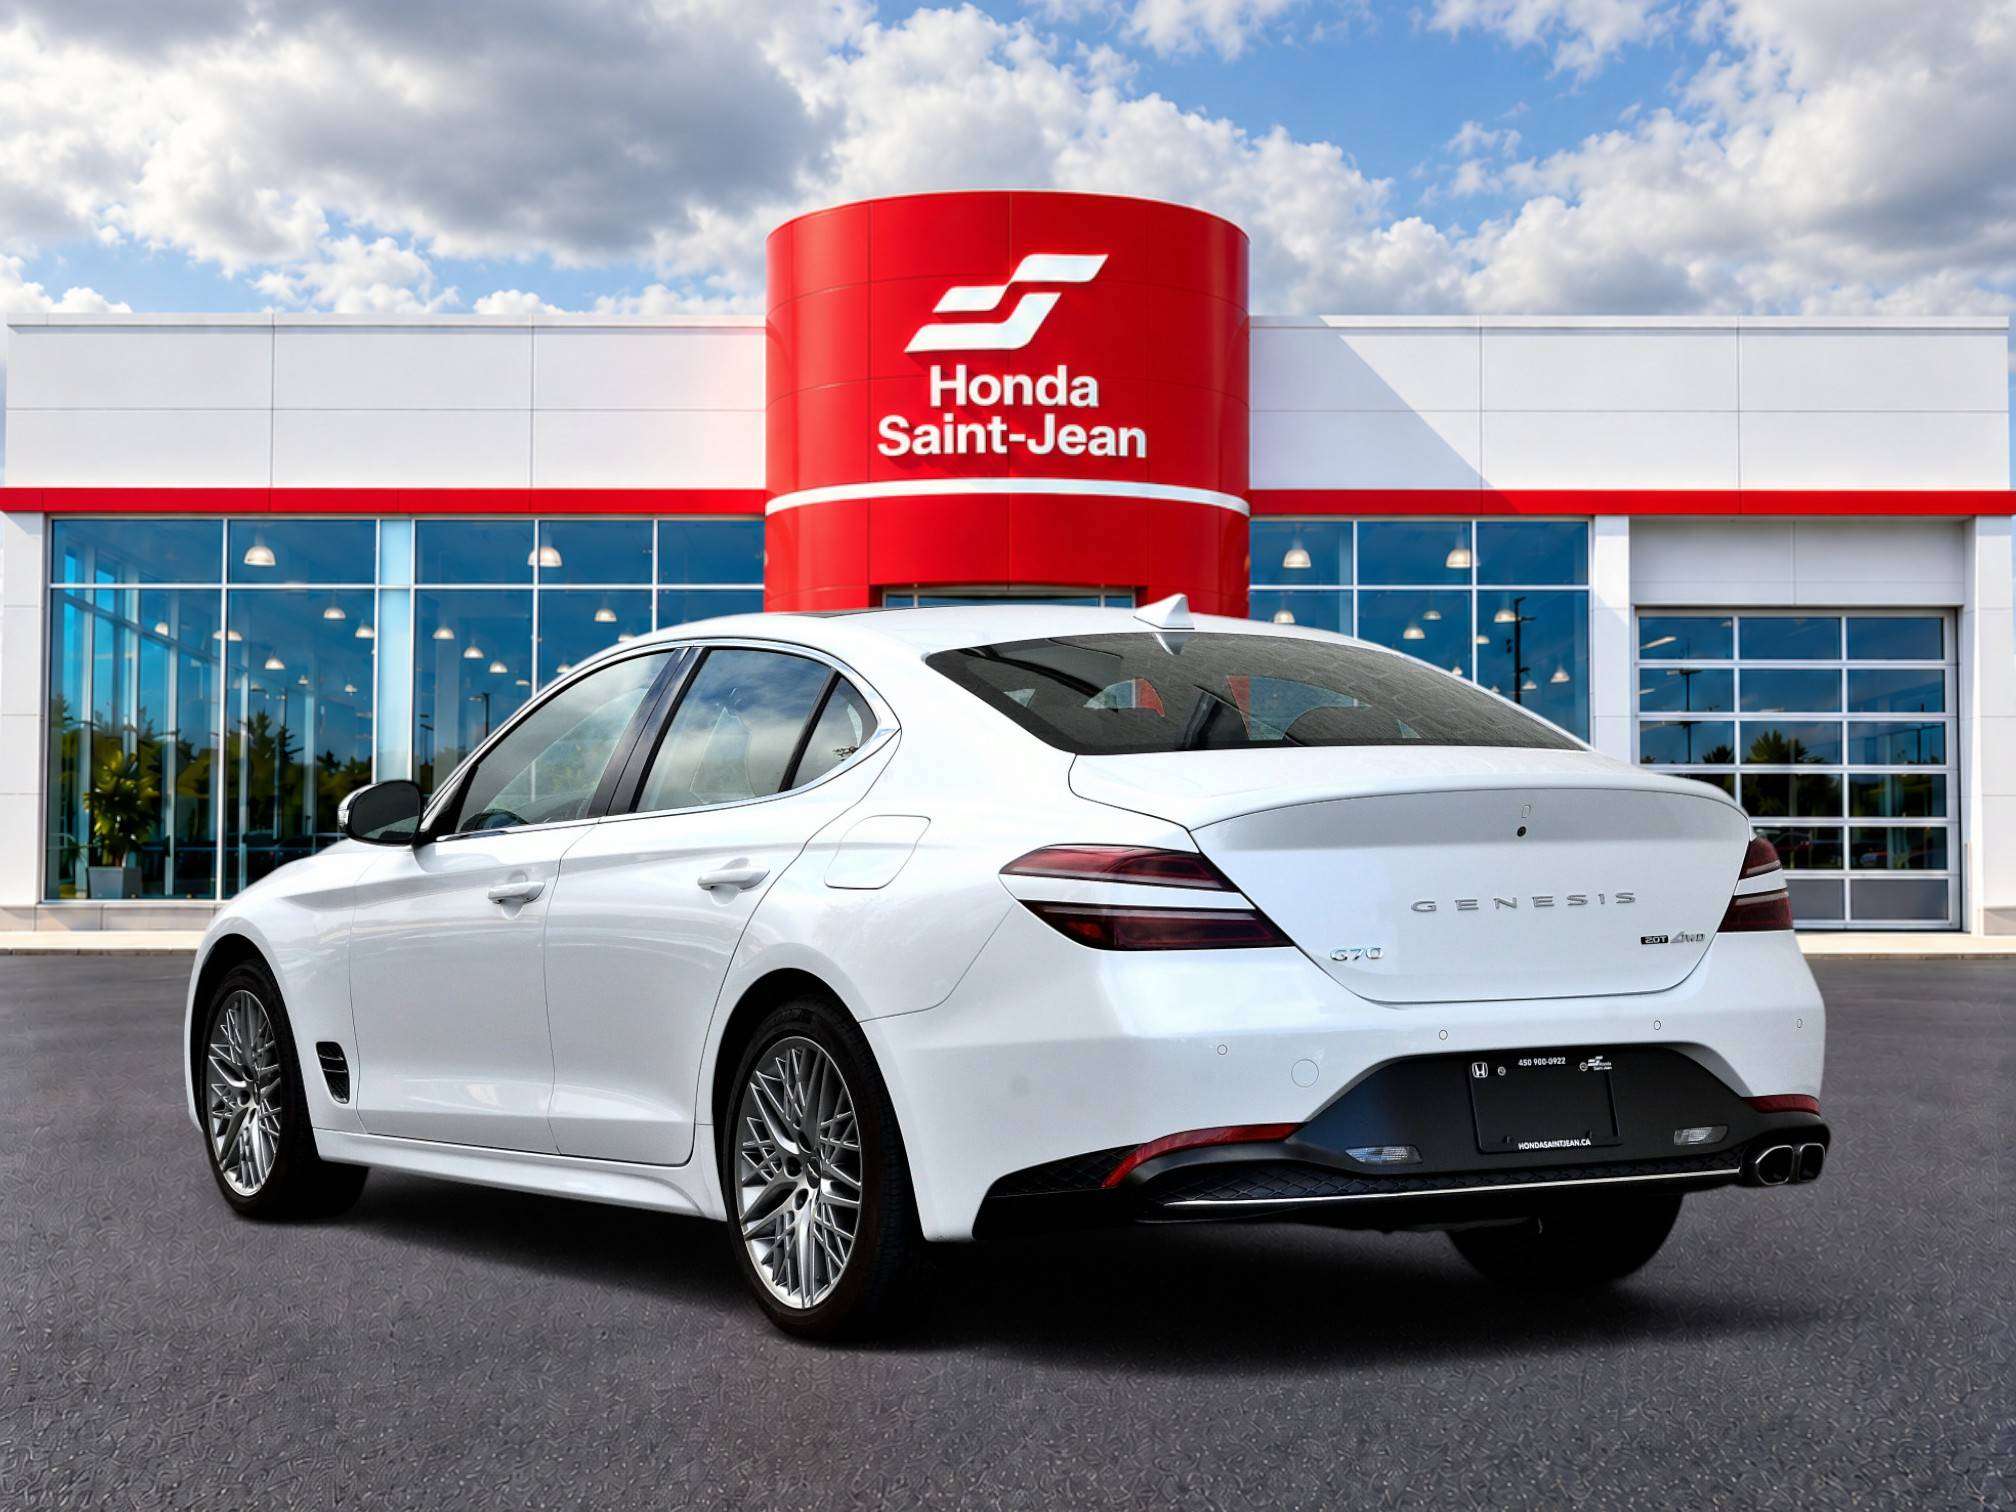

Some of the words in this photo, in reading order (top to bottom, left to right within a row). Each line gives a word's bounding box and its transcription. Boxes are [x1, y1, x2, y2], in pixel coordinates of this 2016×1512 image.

[929, 364, 1099, 407] Honda
[877, 412, 1147, 458] Saint-Jean
[1411, 892, 1637, 913] GENESIS
[1329, 946, 1382, 960] G70
[1518, 1058, 1532, 1066] 450
